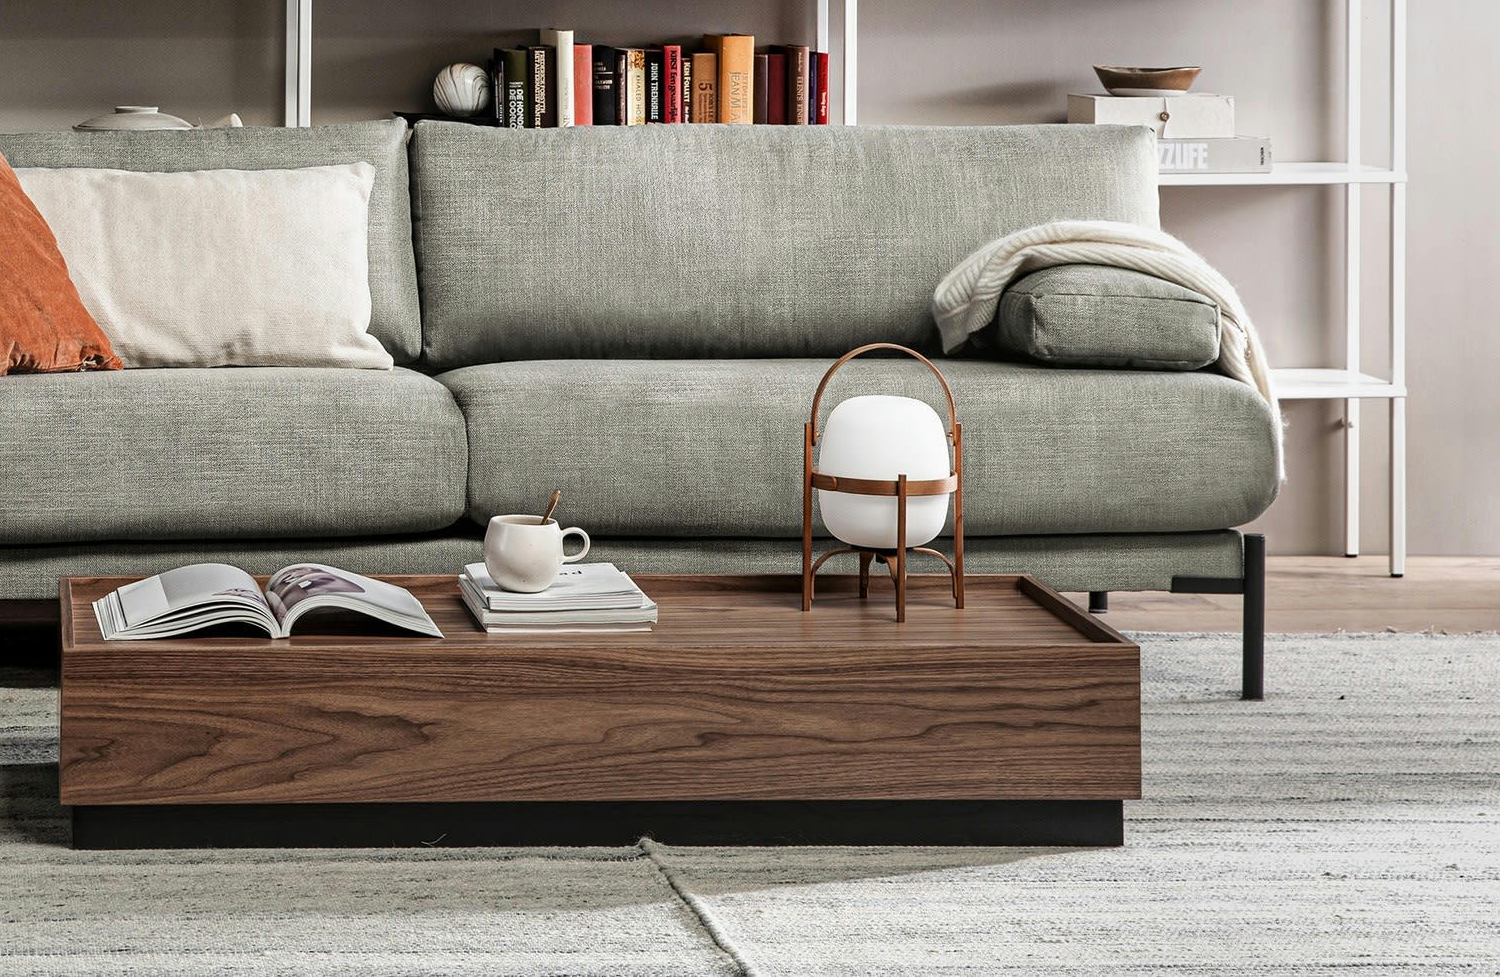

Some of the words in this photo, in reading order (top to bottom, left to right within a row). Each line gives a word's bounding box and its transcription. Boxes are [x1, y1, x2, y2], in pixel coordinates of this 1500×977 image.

[650, 62, 658, 81] JOHN
[698, 82, 712, 91] 5
[730, 71, 740, 95] JEAN
[509, 89, 516, 100] DE
[516, 89, 524, 100] DE
[516, 101, 524, 129] HONDE
[796, 103, 804, 125] KINDE
